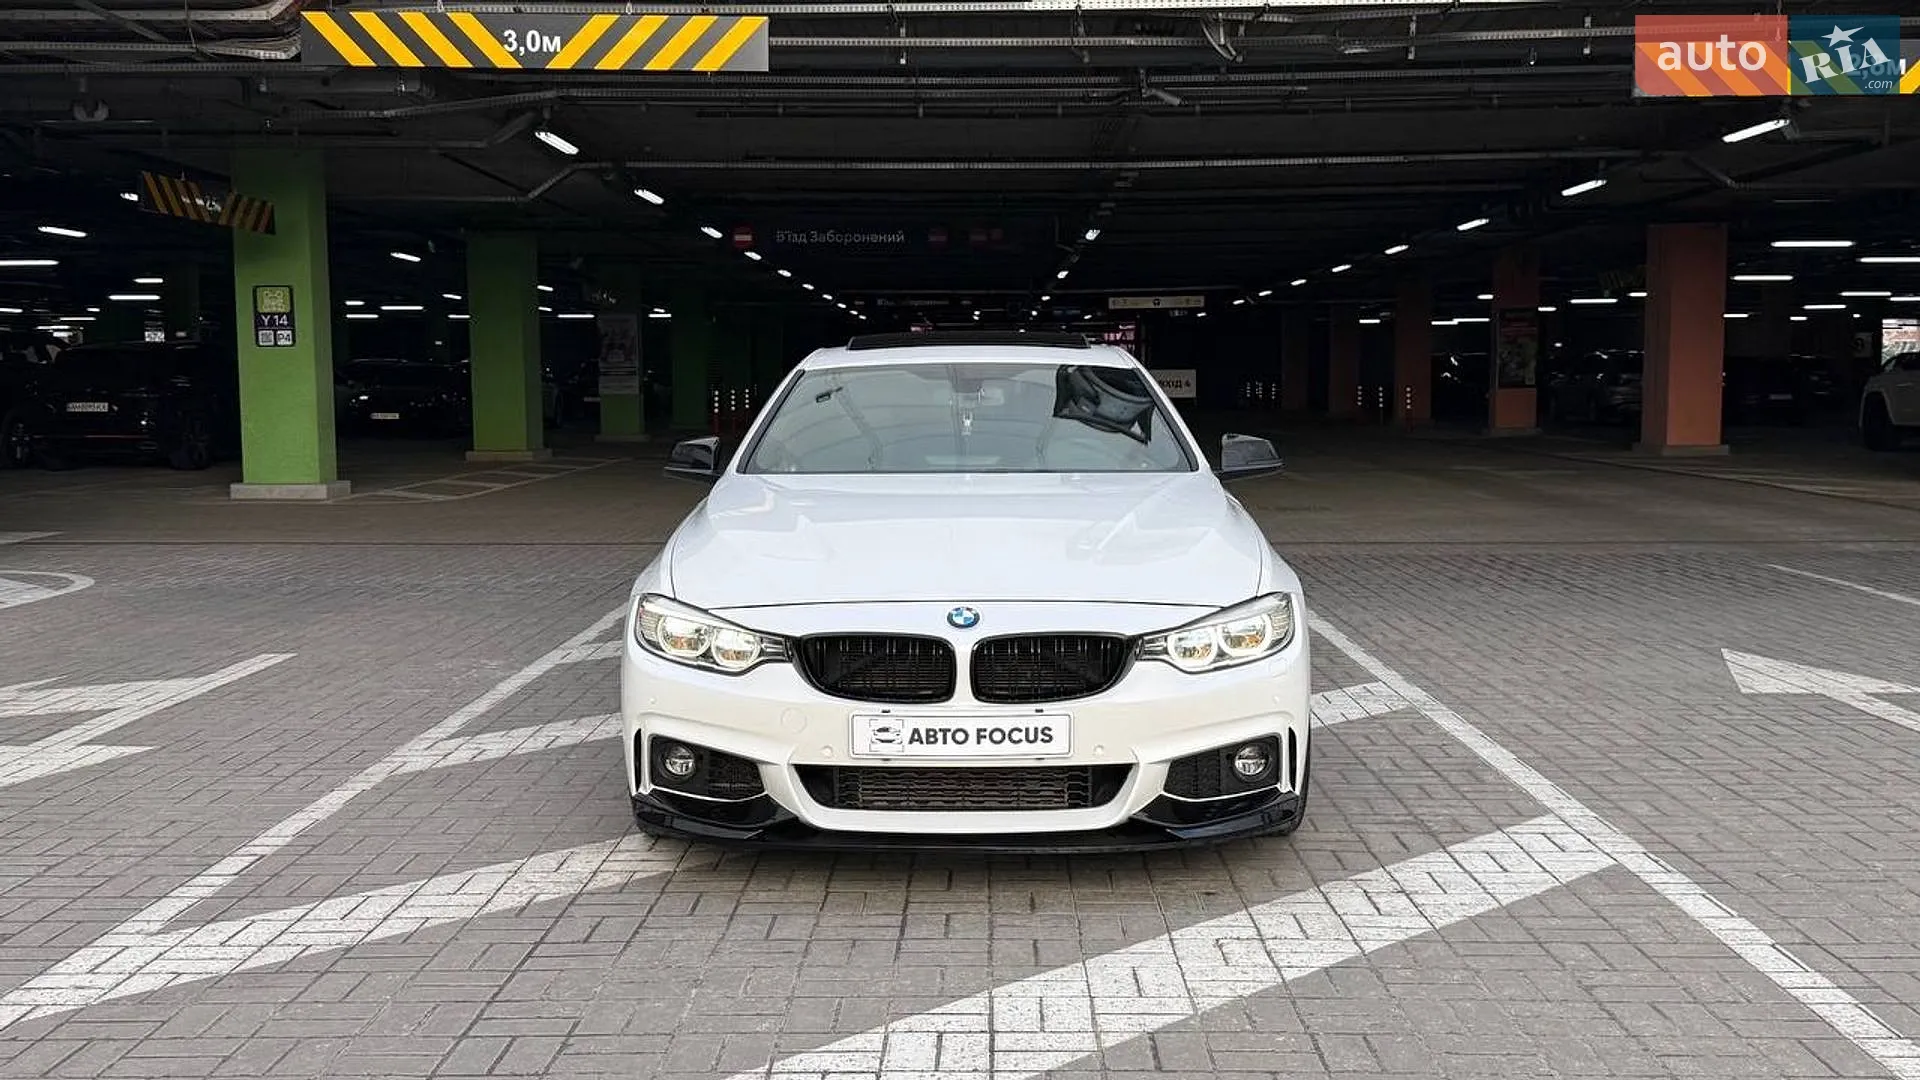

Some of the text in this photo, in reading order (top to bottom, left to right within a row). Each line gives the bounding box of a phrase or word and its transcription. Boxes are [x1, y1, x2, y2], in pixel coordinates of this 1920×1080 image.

[503, 29, 561, 56] 3,0м
[810, 229, 905, 245] Заборонений
[273, 314, 288, 326] 14
[976, 726, 1053, 745] FOCUS
